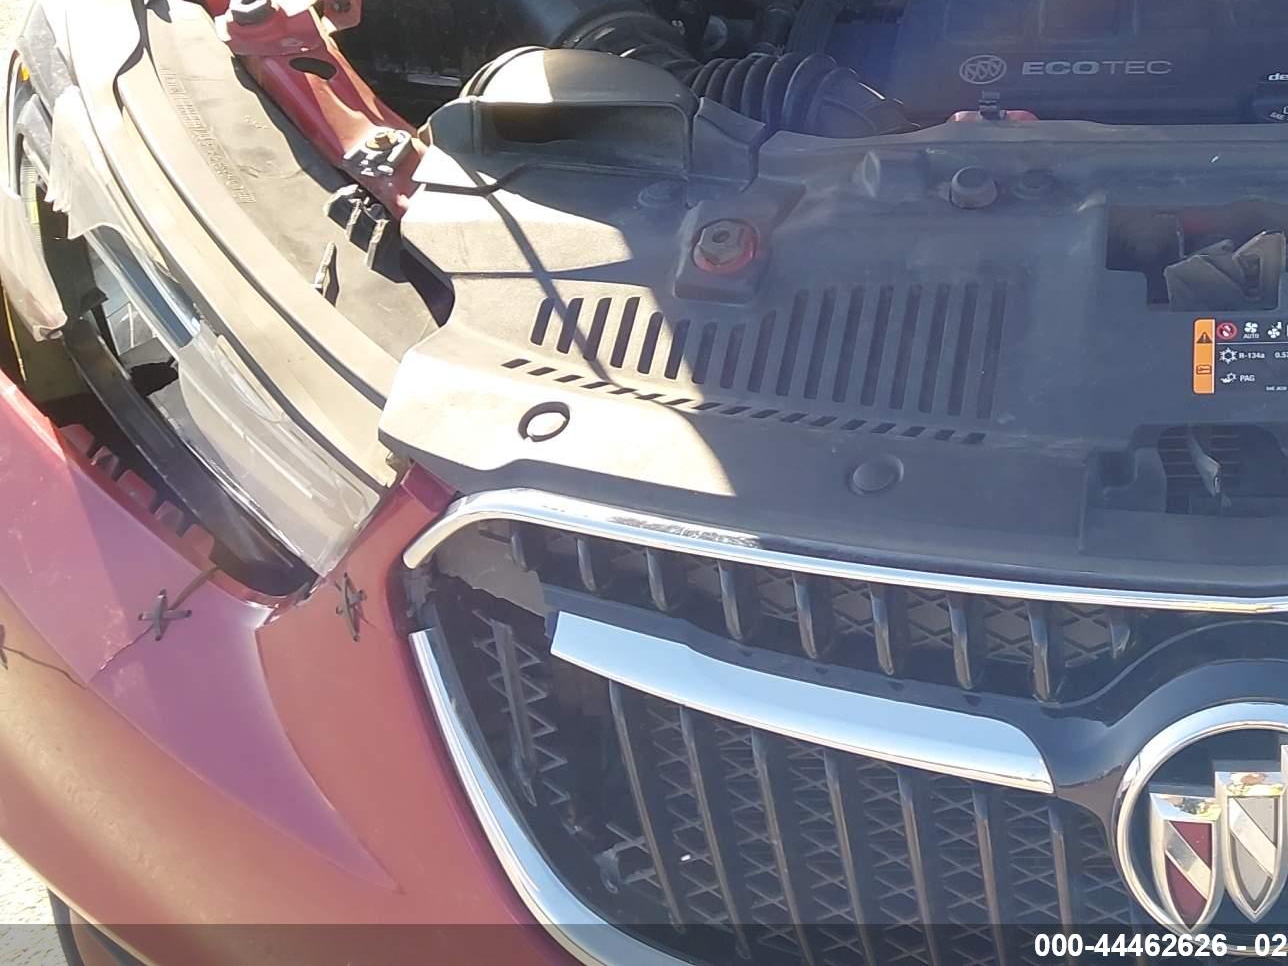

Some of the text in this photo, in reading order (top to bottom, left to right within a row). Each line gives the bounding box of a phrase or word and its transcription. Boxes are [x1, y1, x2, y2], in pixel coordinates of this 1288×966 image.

[1021, 60, 1173, 75] ECOTEC
[1238, 351, 1266, 359] R-134a
[1239, 374, 1256, 382] PAG
